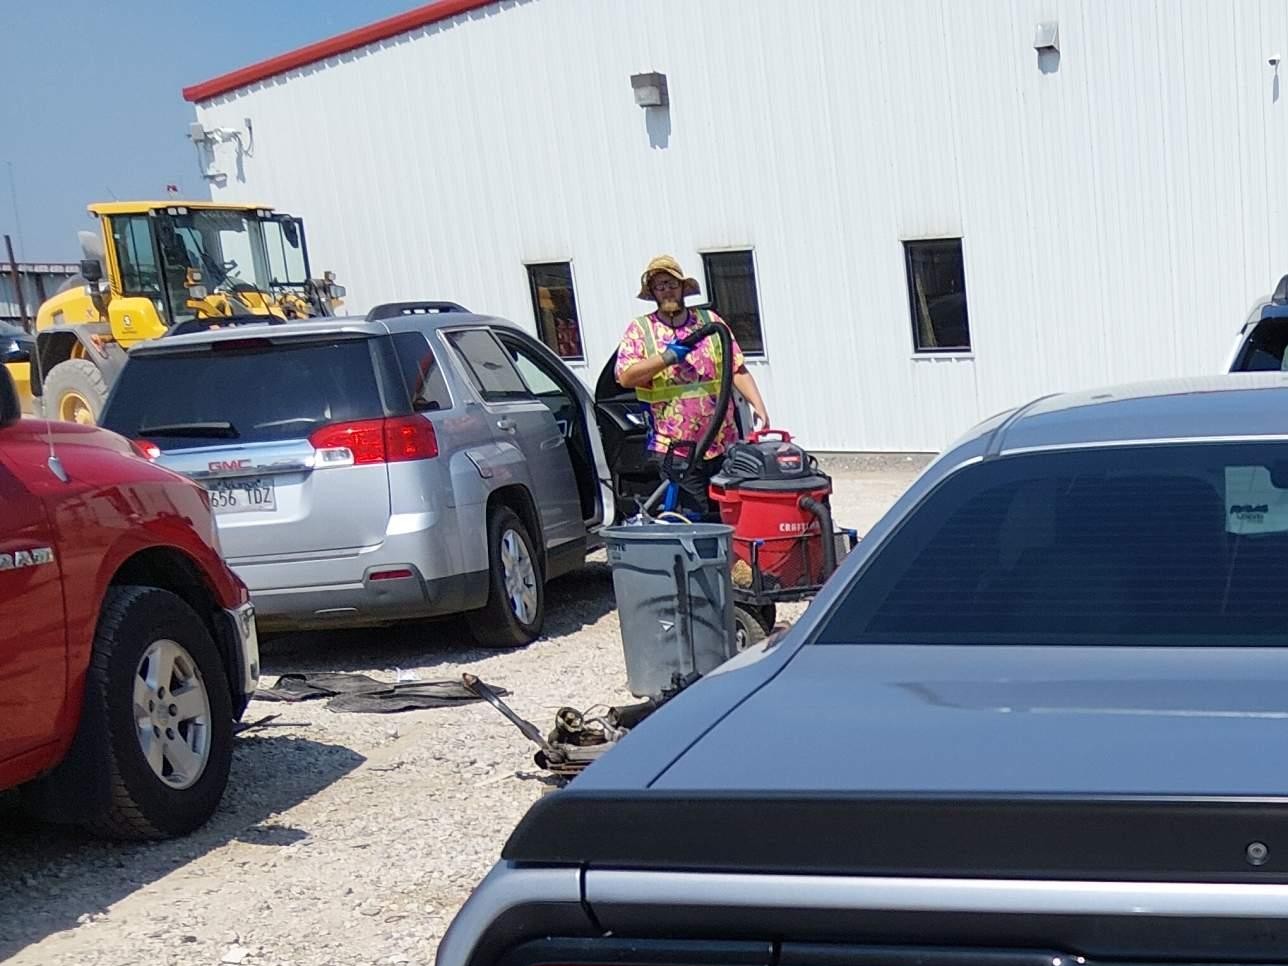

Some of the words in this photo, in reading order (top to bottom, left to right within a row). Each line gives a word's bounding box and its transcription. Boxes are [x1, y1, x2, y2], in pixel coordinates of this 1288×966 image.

[208, 459, 251, 472] GMC
[211, 489, 237, 507] 656
[246, 487, 273, 504] TDZ
